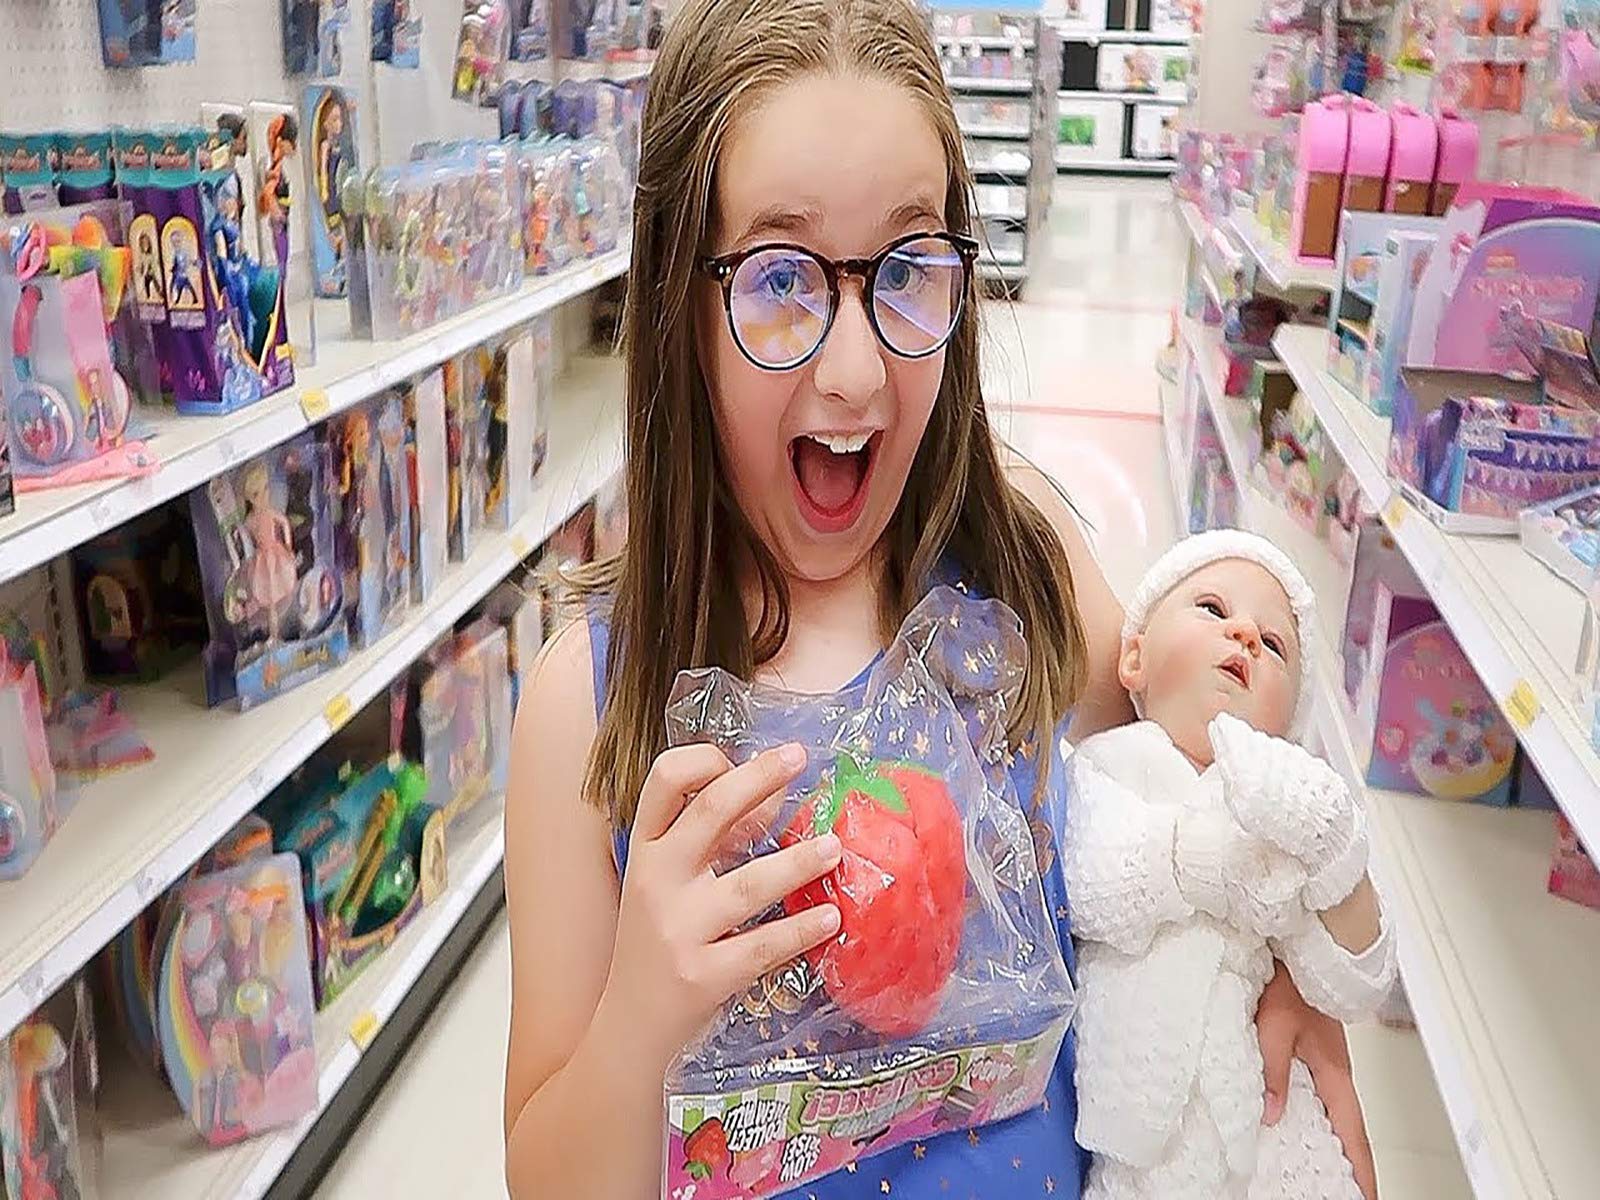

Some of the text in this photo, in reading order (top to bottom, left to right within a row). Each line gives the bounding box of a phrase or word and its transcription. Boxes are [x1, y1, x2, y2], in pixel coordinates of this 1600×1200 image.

[727, 1119, 782, 1152] COLLECT
[782, 1134, 821, 1165] RISE!
[779, 1150, 819, 1182] SLOW
